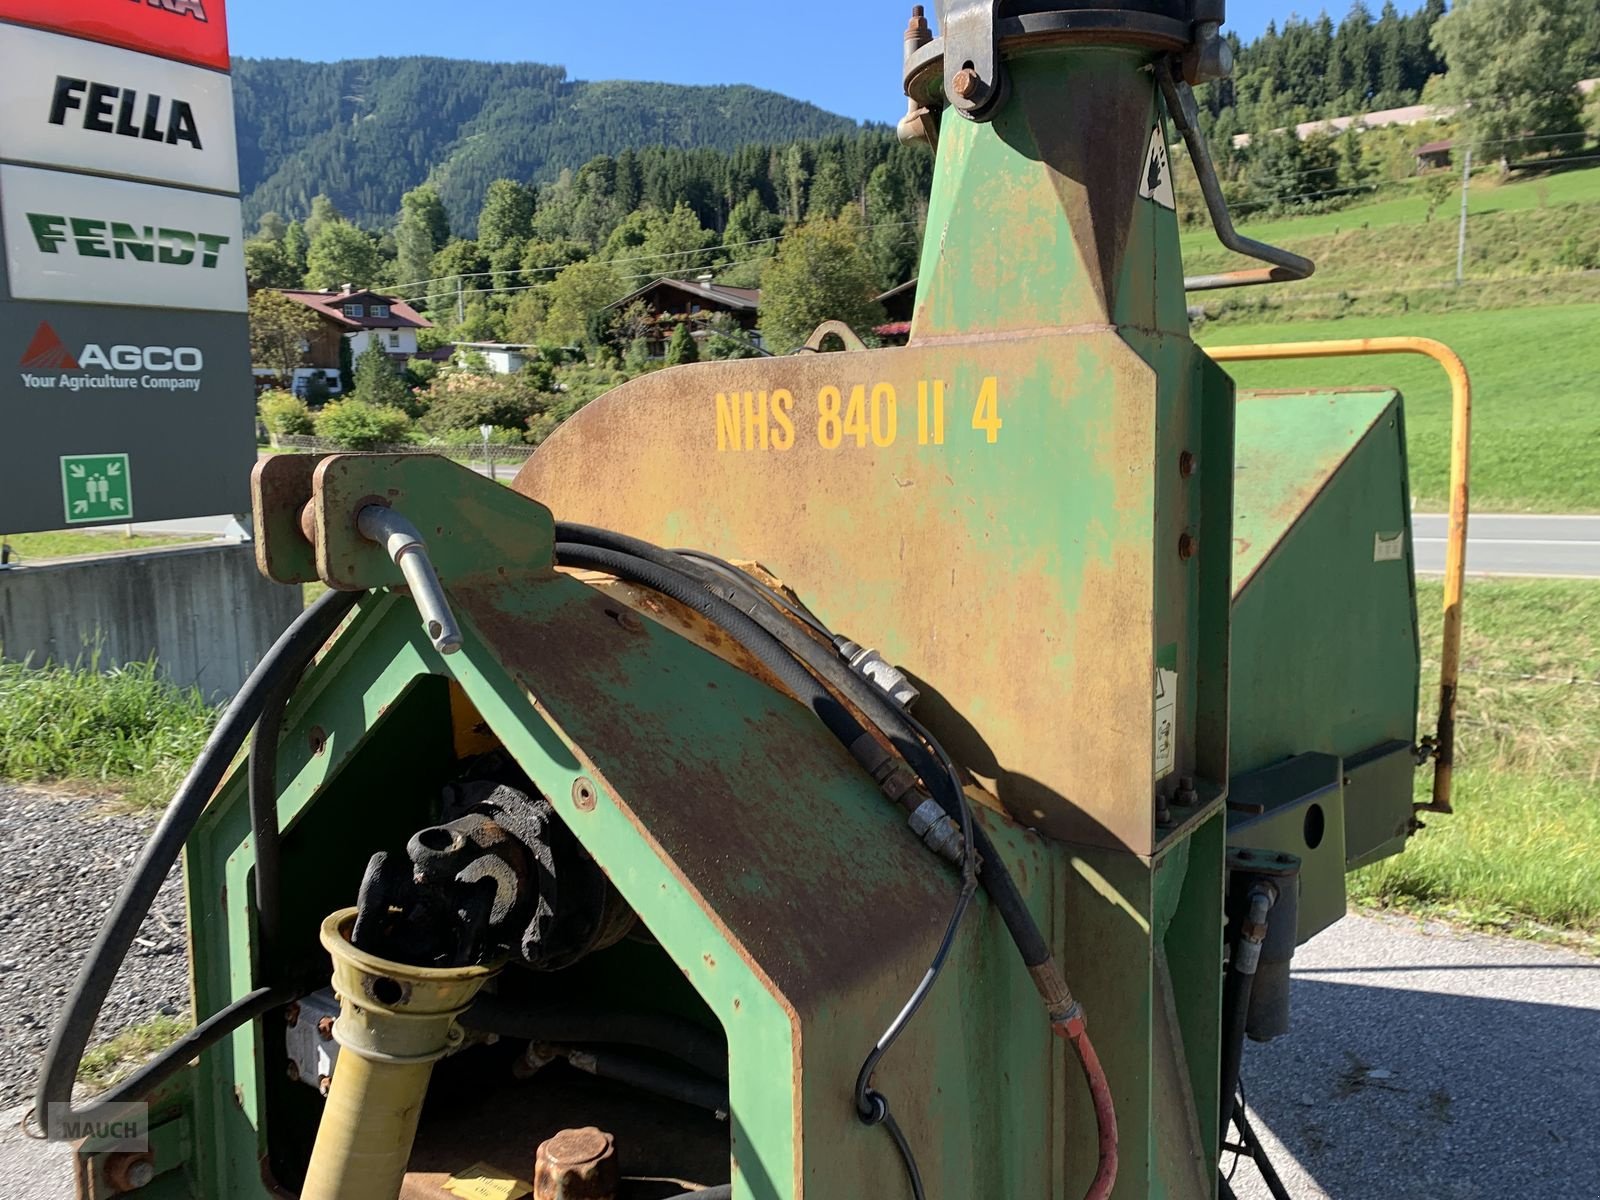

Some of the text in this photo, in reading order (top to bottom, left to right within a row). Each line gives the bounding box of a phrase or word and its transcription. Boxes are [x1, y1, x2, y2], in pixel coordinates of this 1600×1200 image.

[48, 75, 203, 151] FELLA
[25, 212, 230, 269] FENDT
[21, 373, 201, 392] Your Agriculture Company
[78, 343, 203, 372] AGCO
[716, 388, 795, 451] NHS
[817, 382, 897, 449] 840
[972, 376, 1002, 444] 4
